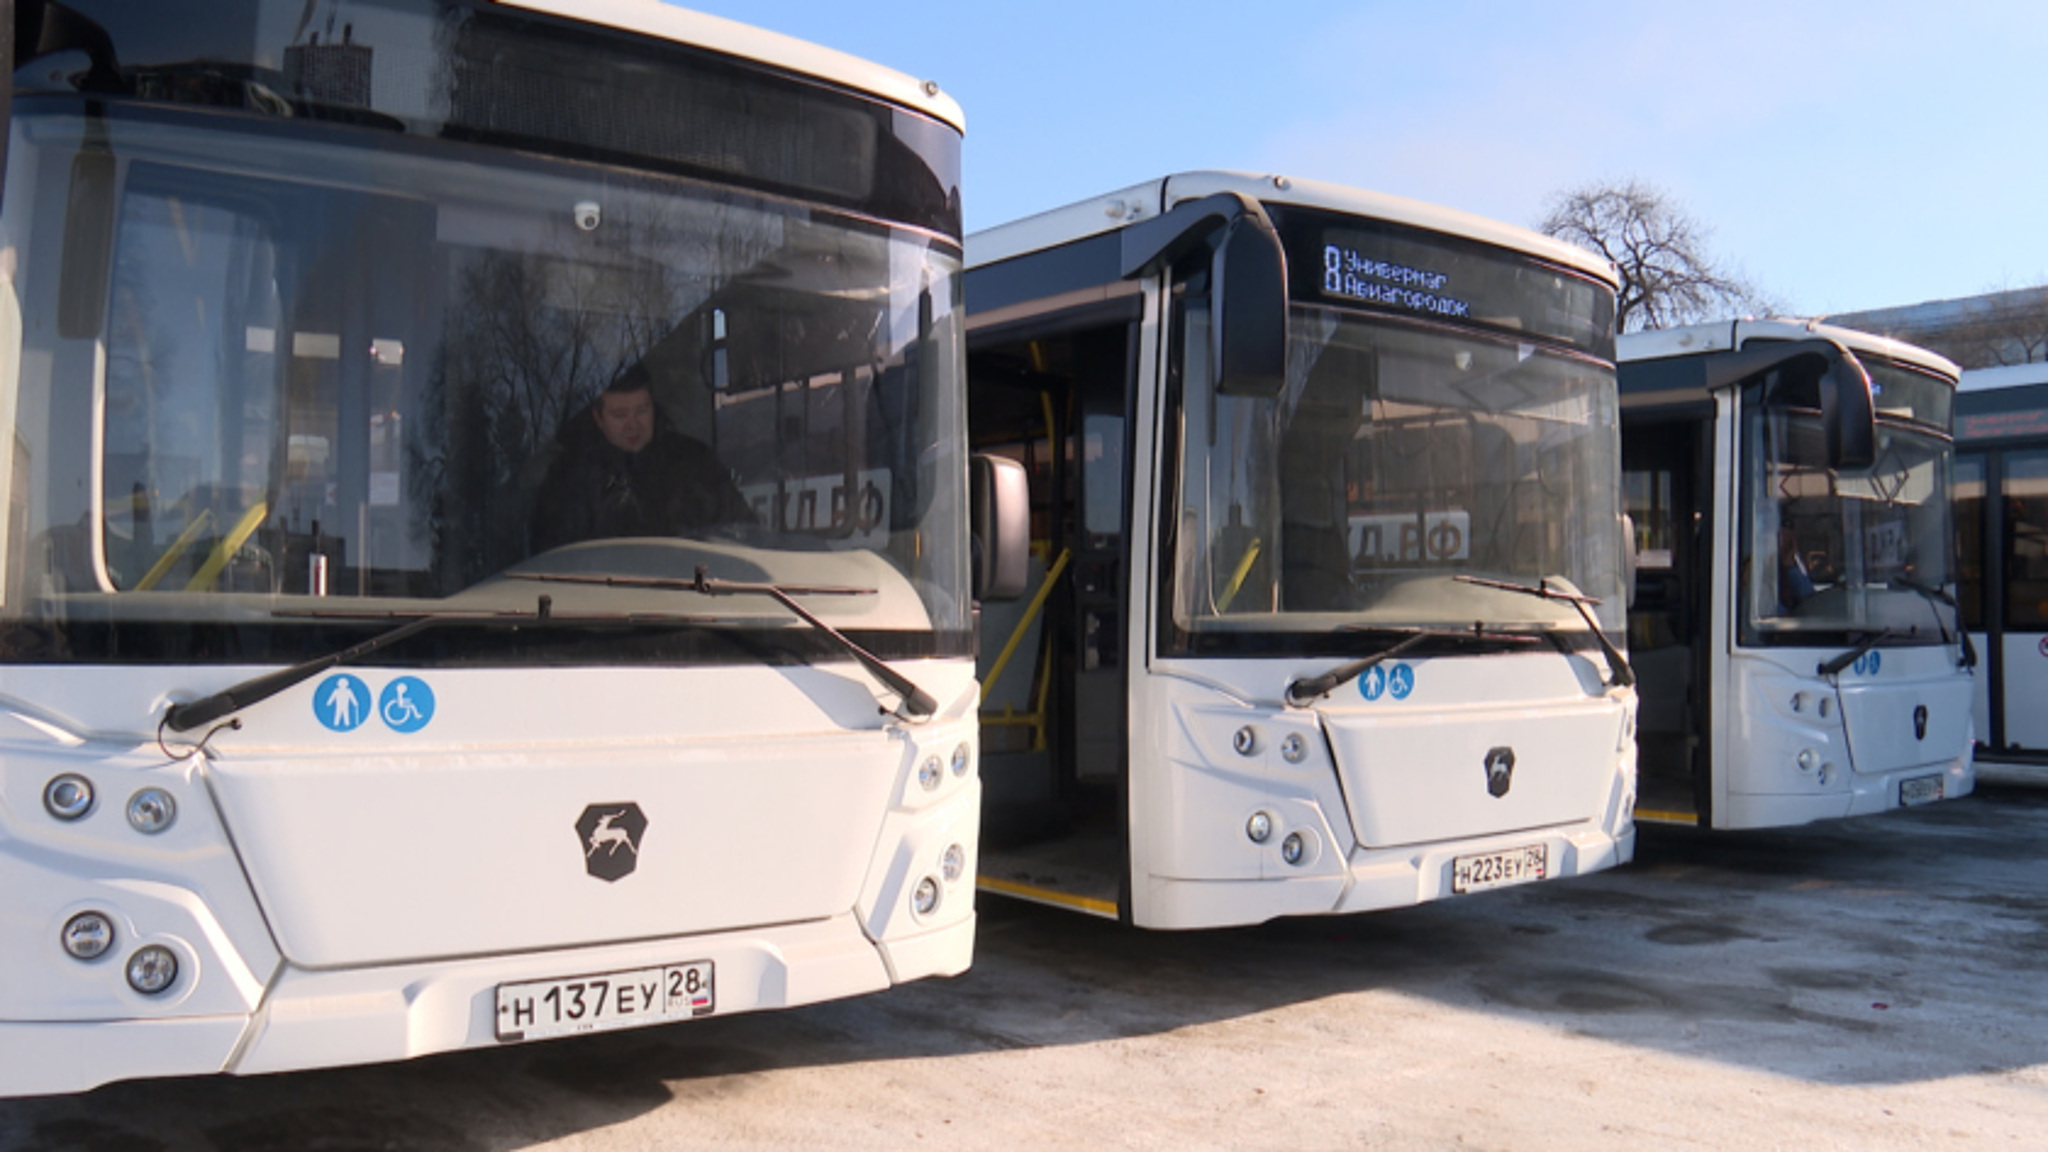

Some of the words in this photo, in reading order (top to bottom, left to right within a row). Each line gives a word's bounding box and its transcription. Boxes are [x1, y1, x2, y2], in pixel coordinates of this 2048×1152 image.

[1325, 245, 1341, 292] 8
[1344, 250, 1447, 290] Универмаг
[1345, 273, 1470, 316] Авиагородок
[668, 968, 701, 997] 28
